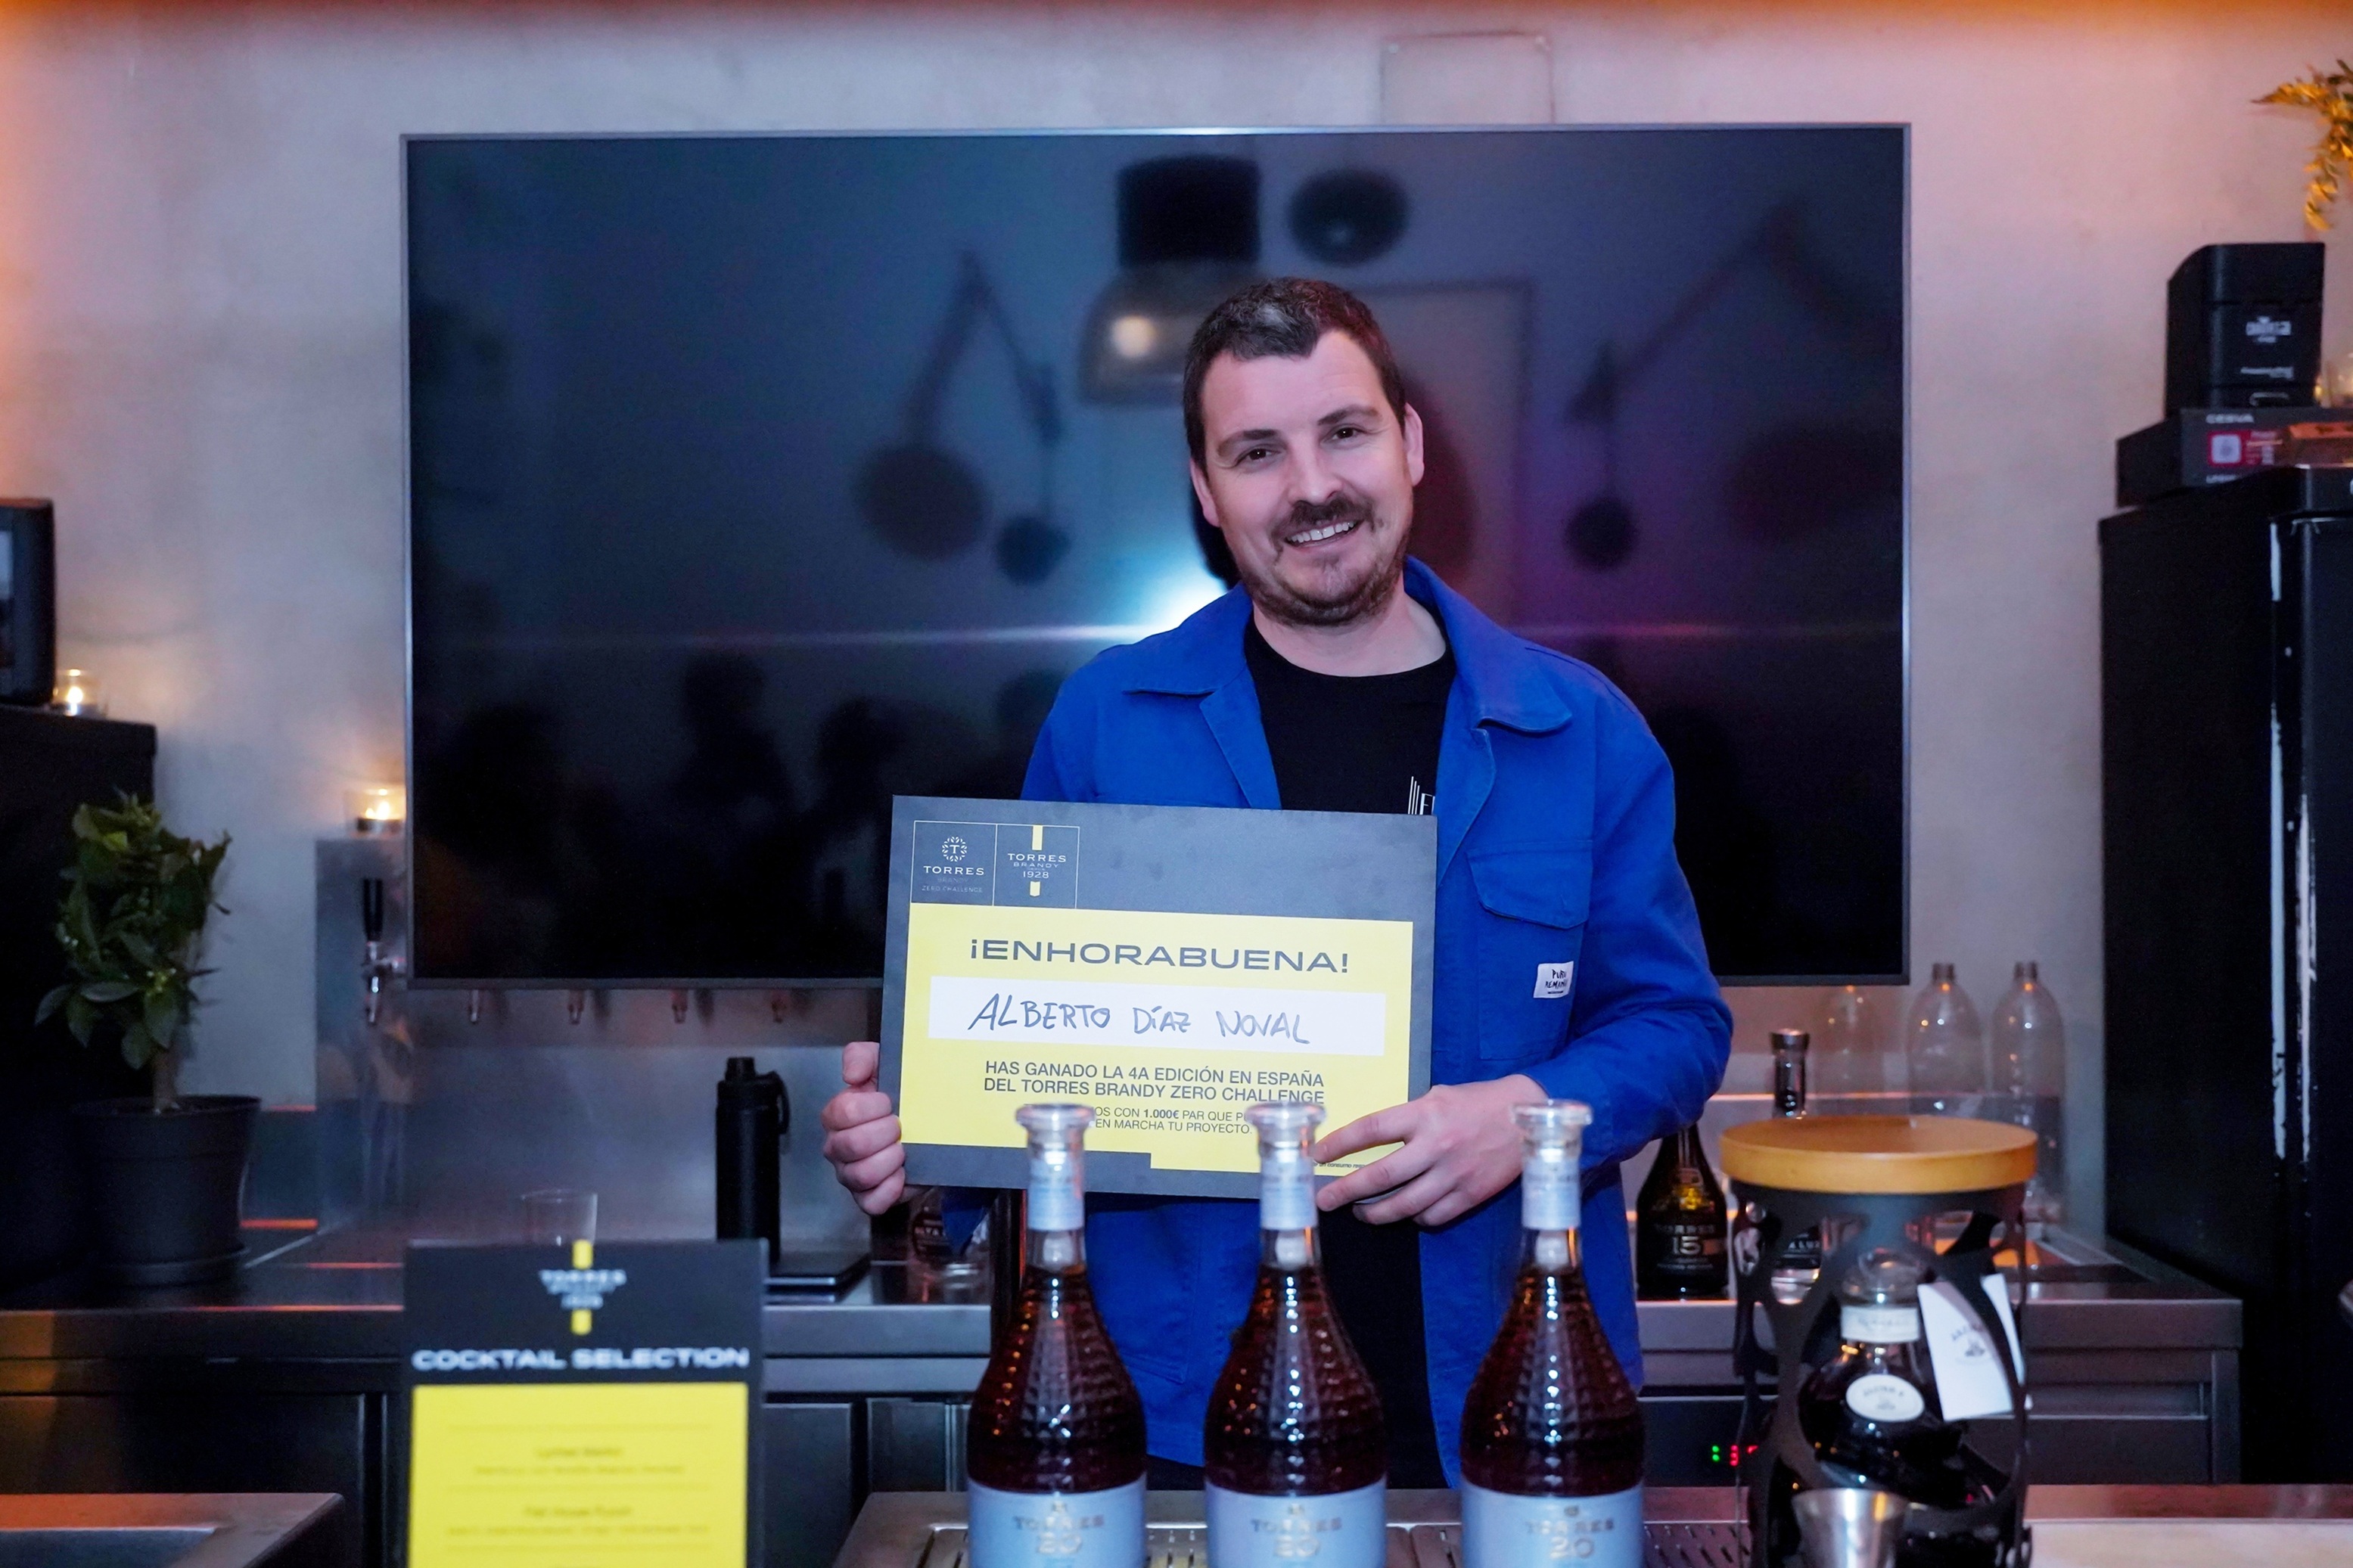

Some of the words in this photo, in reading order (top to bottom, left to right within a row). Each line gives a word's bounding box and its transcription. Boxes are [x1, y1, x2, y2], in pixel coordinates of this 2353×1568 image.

[1007, 853, 1067, 862] TORRES
[923, 865, 984, 876] TORRES
[1023, 871, 1049, 879] 1928
[971, 939, 1349, 973] ¡ENHORABUENA!
[967, 992, 1111, 1031] ALBERTO
[1215, 1010, 1311, 1045] NOVAL
[985, 1060, 1020, 1075] HAS
[1024, 1062, 1098, 1078] GANADO
[1102, 1065, 1124, 1079] LA
[1128, 1067, 1149, 1080] 4A
[1155, 1066, 1224, 1083] EDICIÓN
[1229, 1070, 1252, 1084] EN
[1257, 1070, 1324, 1087] ESPAÑA
[984, 1077, 1016, 1092] DEL
[1021, 1079, 1089, 1095] TORRES
[1095, 1082, 1166, 1098] BRANDY
[1170, 1085, 1217, 1101] ZERO
[1222, 1087, 1325, 1104] CHALLENGE
[1114, 1107, 1139, 1118] CON
[1143, 1108, 1180, 1119] 1.000€
[1182, 1110, 1204, 1121] PAR
[1208, 1111, 1232, 1122] QUE
[1095, 1119, 1111, 1129] EN
[1114, 1119, 1164, 1131] MARCHA
[1168, 1121, 1183, 1132] TU
[1186, 1122, 1253, 1135] PROYECTO.
[1673, 1235, 1702, 1255] 15
[411, 1348, 568, 1372] COCKTAIL
[570, 1346, 751, 1370] SELECTION
[1550, 1536, 1595, 1560] 20
